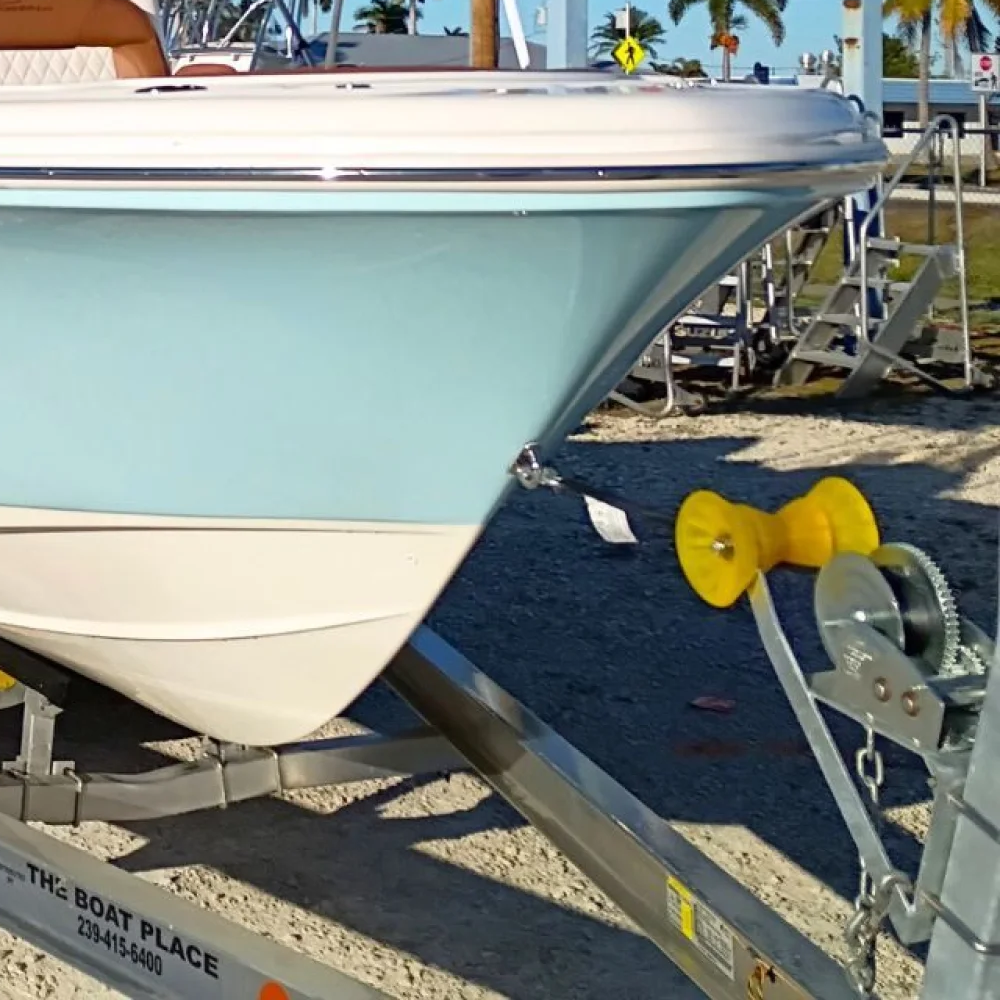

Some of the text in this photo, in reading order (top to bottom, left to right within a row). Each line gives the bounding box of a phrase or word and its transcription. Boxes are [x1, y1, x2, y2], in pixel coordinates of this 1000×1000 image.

[27, 862, 69, 901] THE
[75, 886, 134, 932] BOAT
[140, 919, 220, 979] PLACE
[77, 915, 163, 976] 239-415-6400
